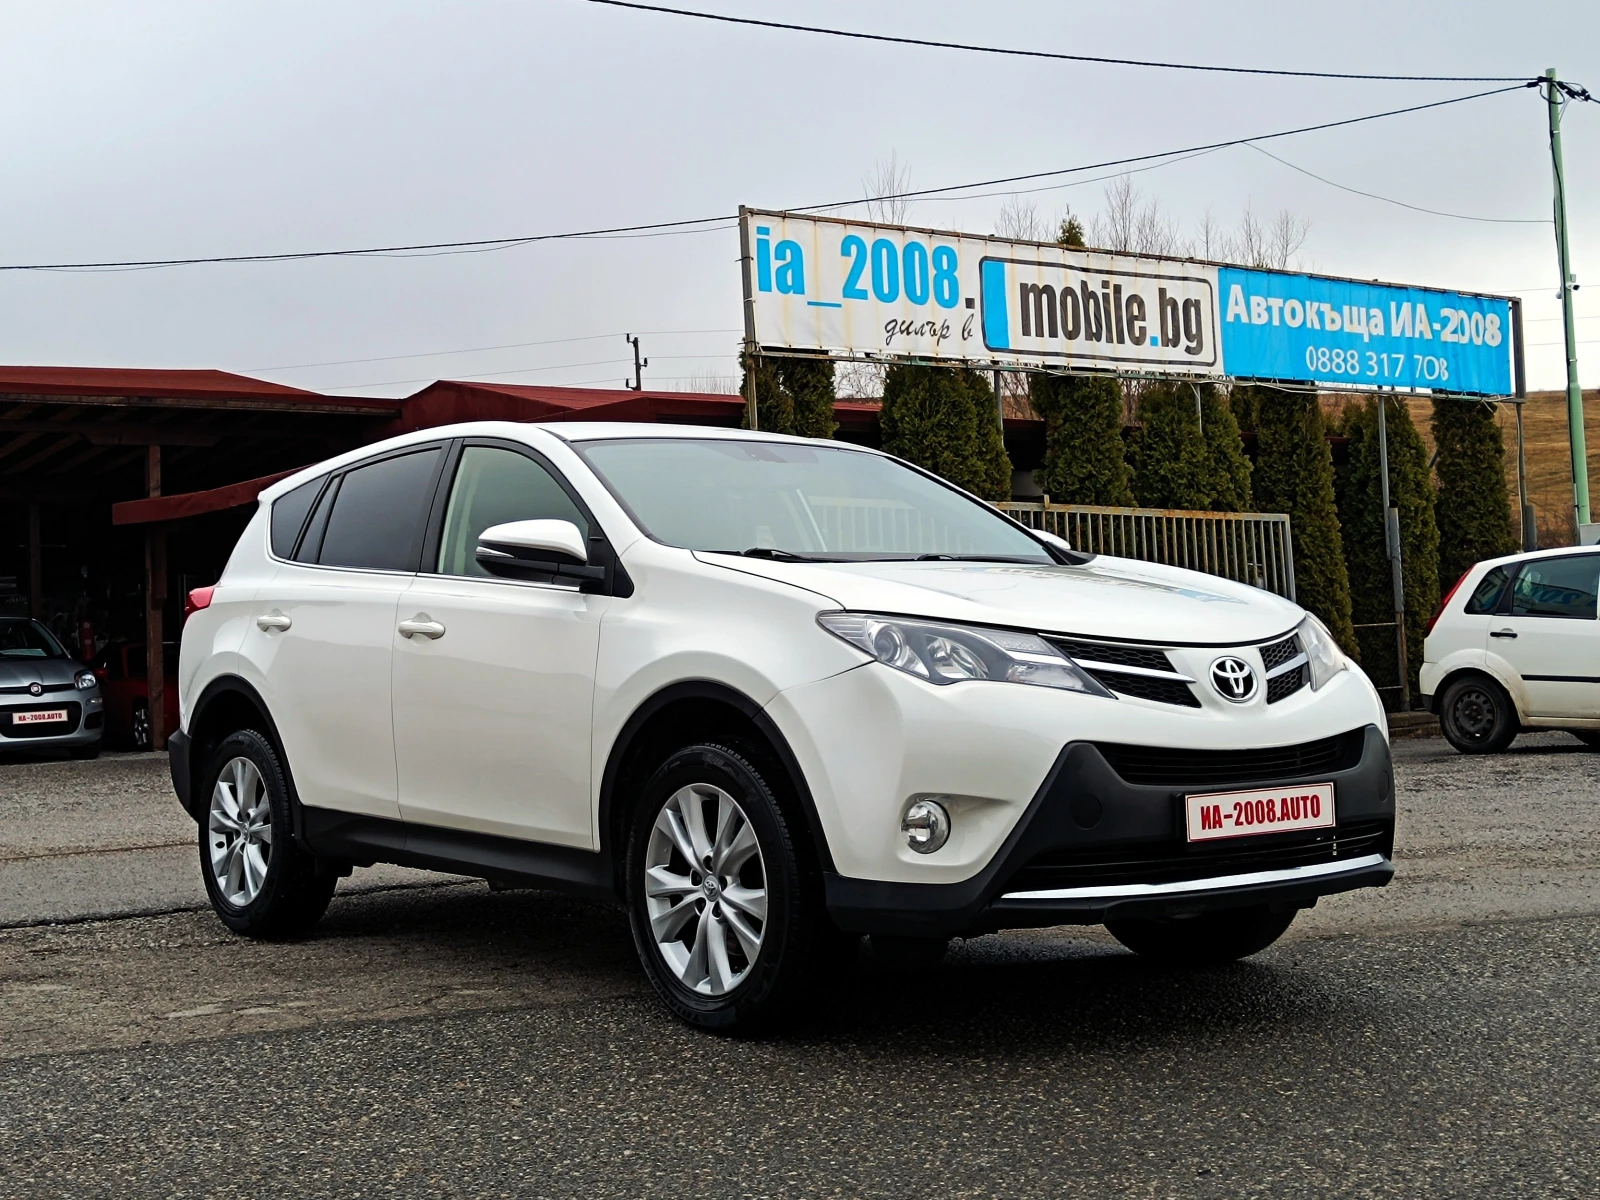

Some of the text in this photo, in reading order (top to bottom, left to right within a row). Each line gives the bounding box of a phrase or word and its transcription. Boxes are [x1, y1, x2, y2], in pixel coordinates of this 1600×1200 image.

[884, 318, 951, 346] дилър
[1019, 280, 1204, 356] mobile.bg
[1226, 284, 1503, 347] Автокъща ИА-2008
[1305, 346, 1449, 381] 0888 317 708
